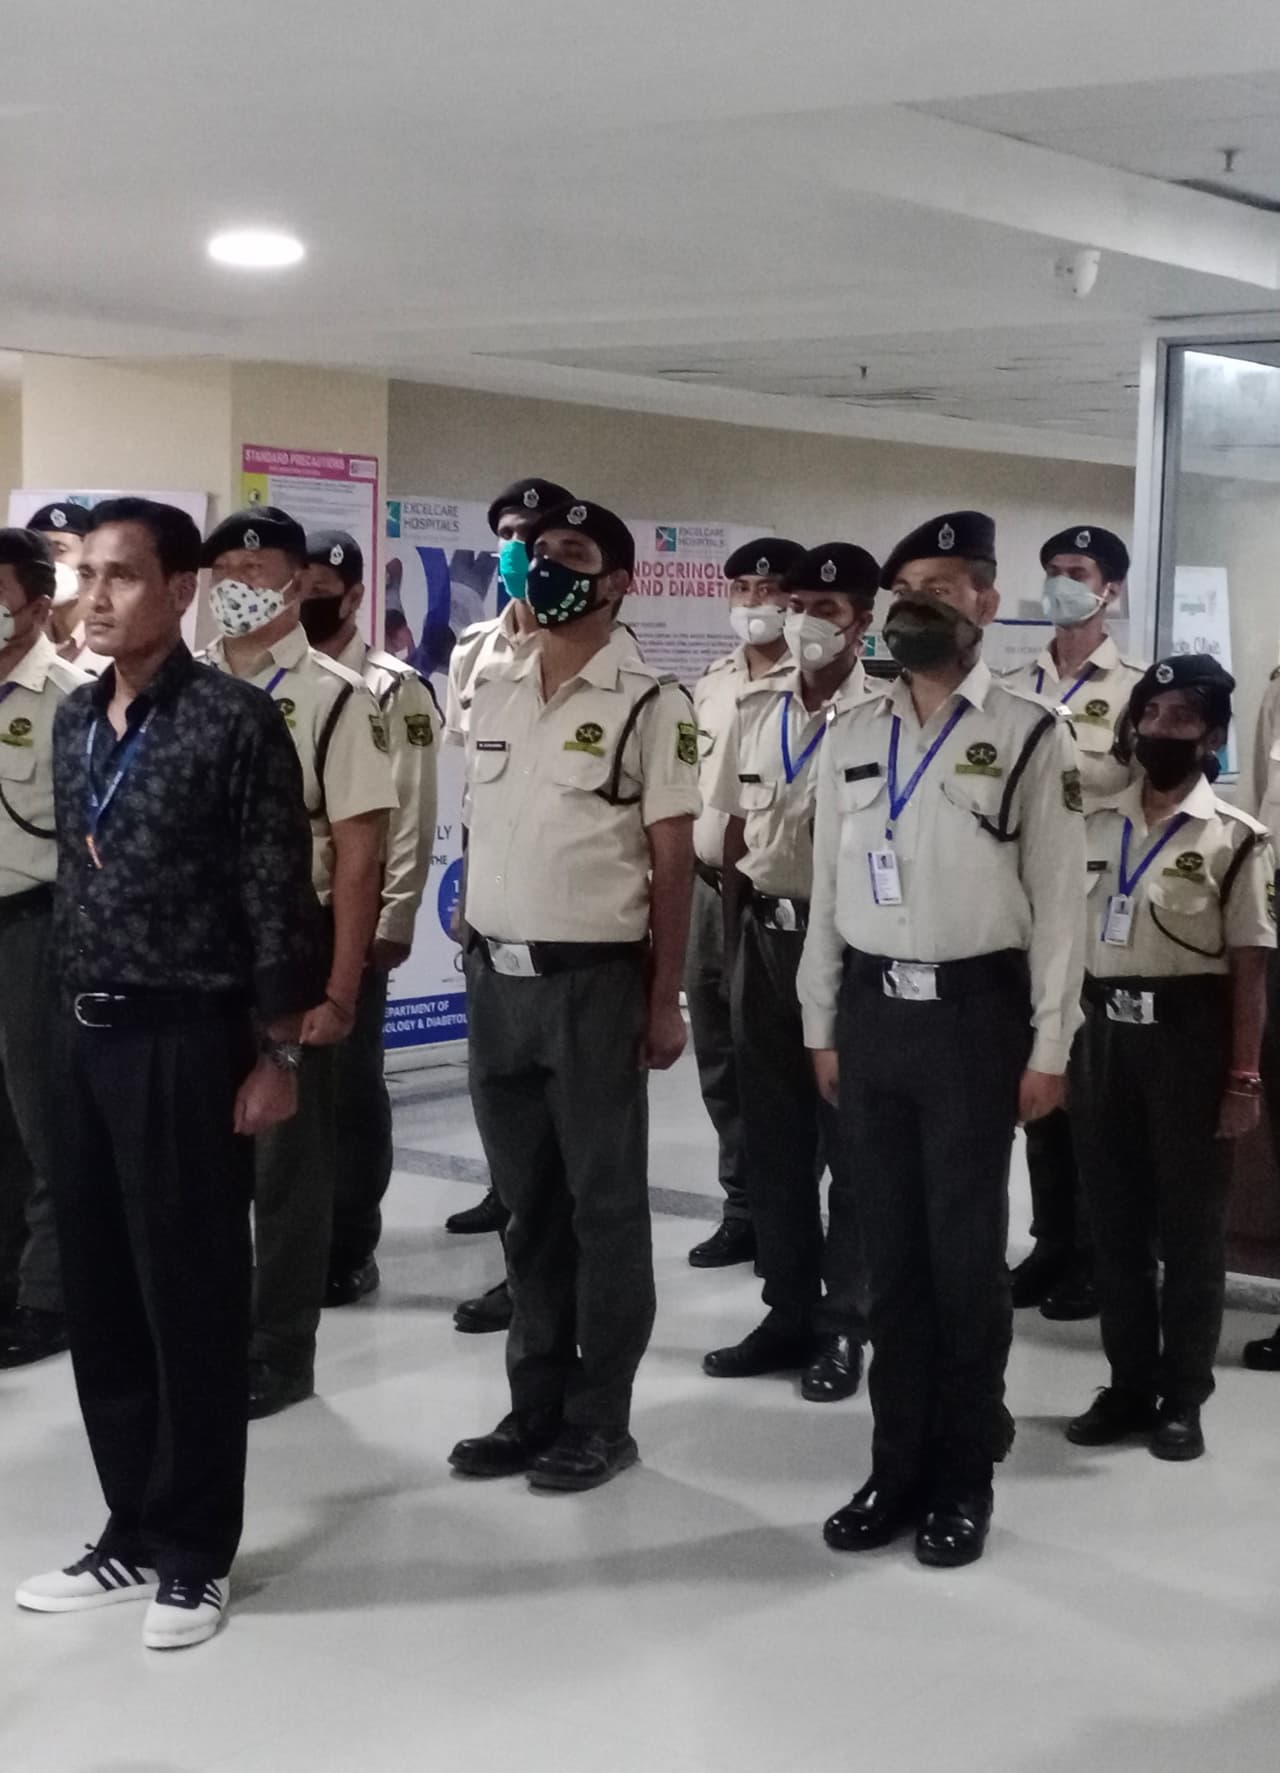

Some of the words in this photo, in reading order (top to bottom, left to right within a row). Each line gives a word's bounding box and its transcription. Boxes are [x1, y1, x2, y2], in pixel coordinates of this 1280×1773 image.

[245, 449, 289, 464] STANDARD
[290, 453, 345, 470] PRECAUTIONS
[404, 502, 459, 517] EXCELCARE
[404, 518, 459, 532] HOSPITALS
[679, 527, 724, 537] EXCELCARE
[634, 561, 724, 580] NDOCRINOL
[628, 579, 664, 596] AND
[669, 580, 729, 598] DIABETI
[437, 826, 453, 840] LY
[384, 1002, 436, 1018] EPARTMENT
[437, 1000, 449, 1012] OF
[382, 1020, 416, 1033] OLOGY
[417, 1018, 425, 1029] &
[426, 1013, 468, 1028] DIABETOL
